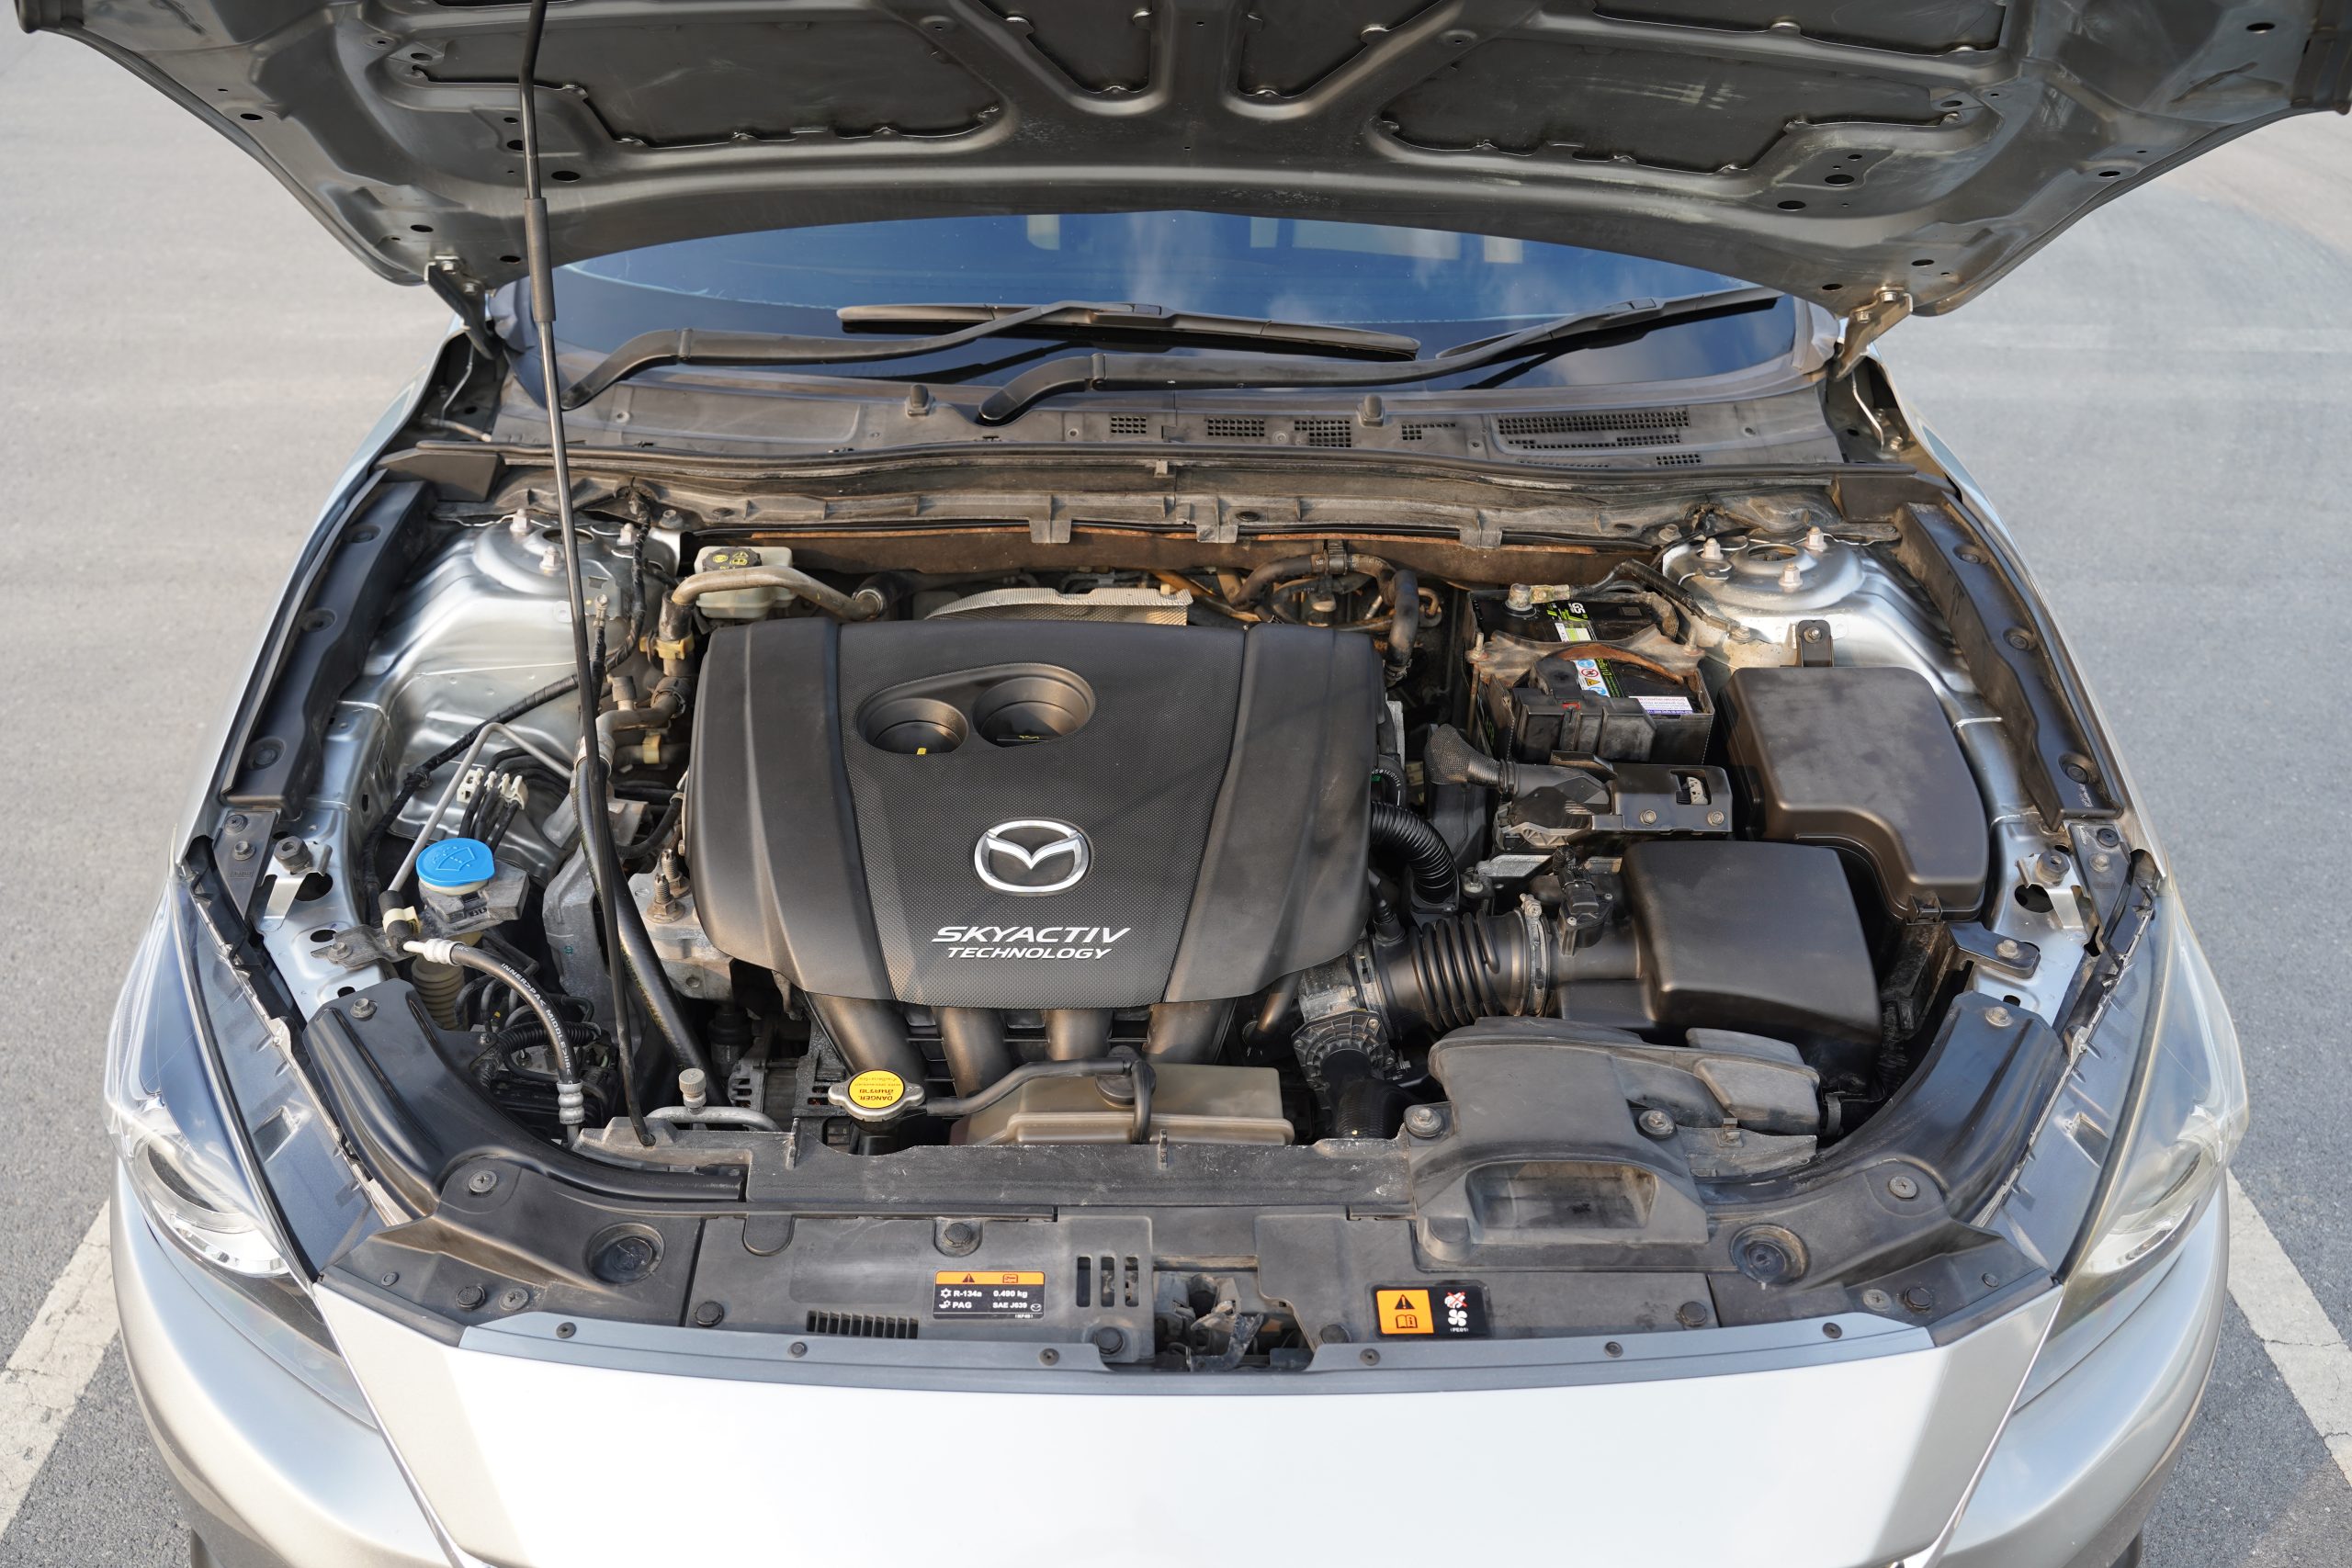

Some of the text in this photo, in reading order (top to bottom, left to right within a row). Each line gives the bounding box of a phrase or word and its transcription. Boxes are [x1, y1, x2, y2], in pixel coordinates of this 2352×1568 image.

[931, 926, 1132, 943] SKYACTIV
[947, 947, 1113, 960] TECHNOLOGY
[953, 1290, 982, 1298] R-134a
[1017, 1290, 1028, 1299] kg
